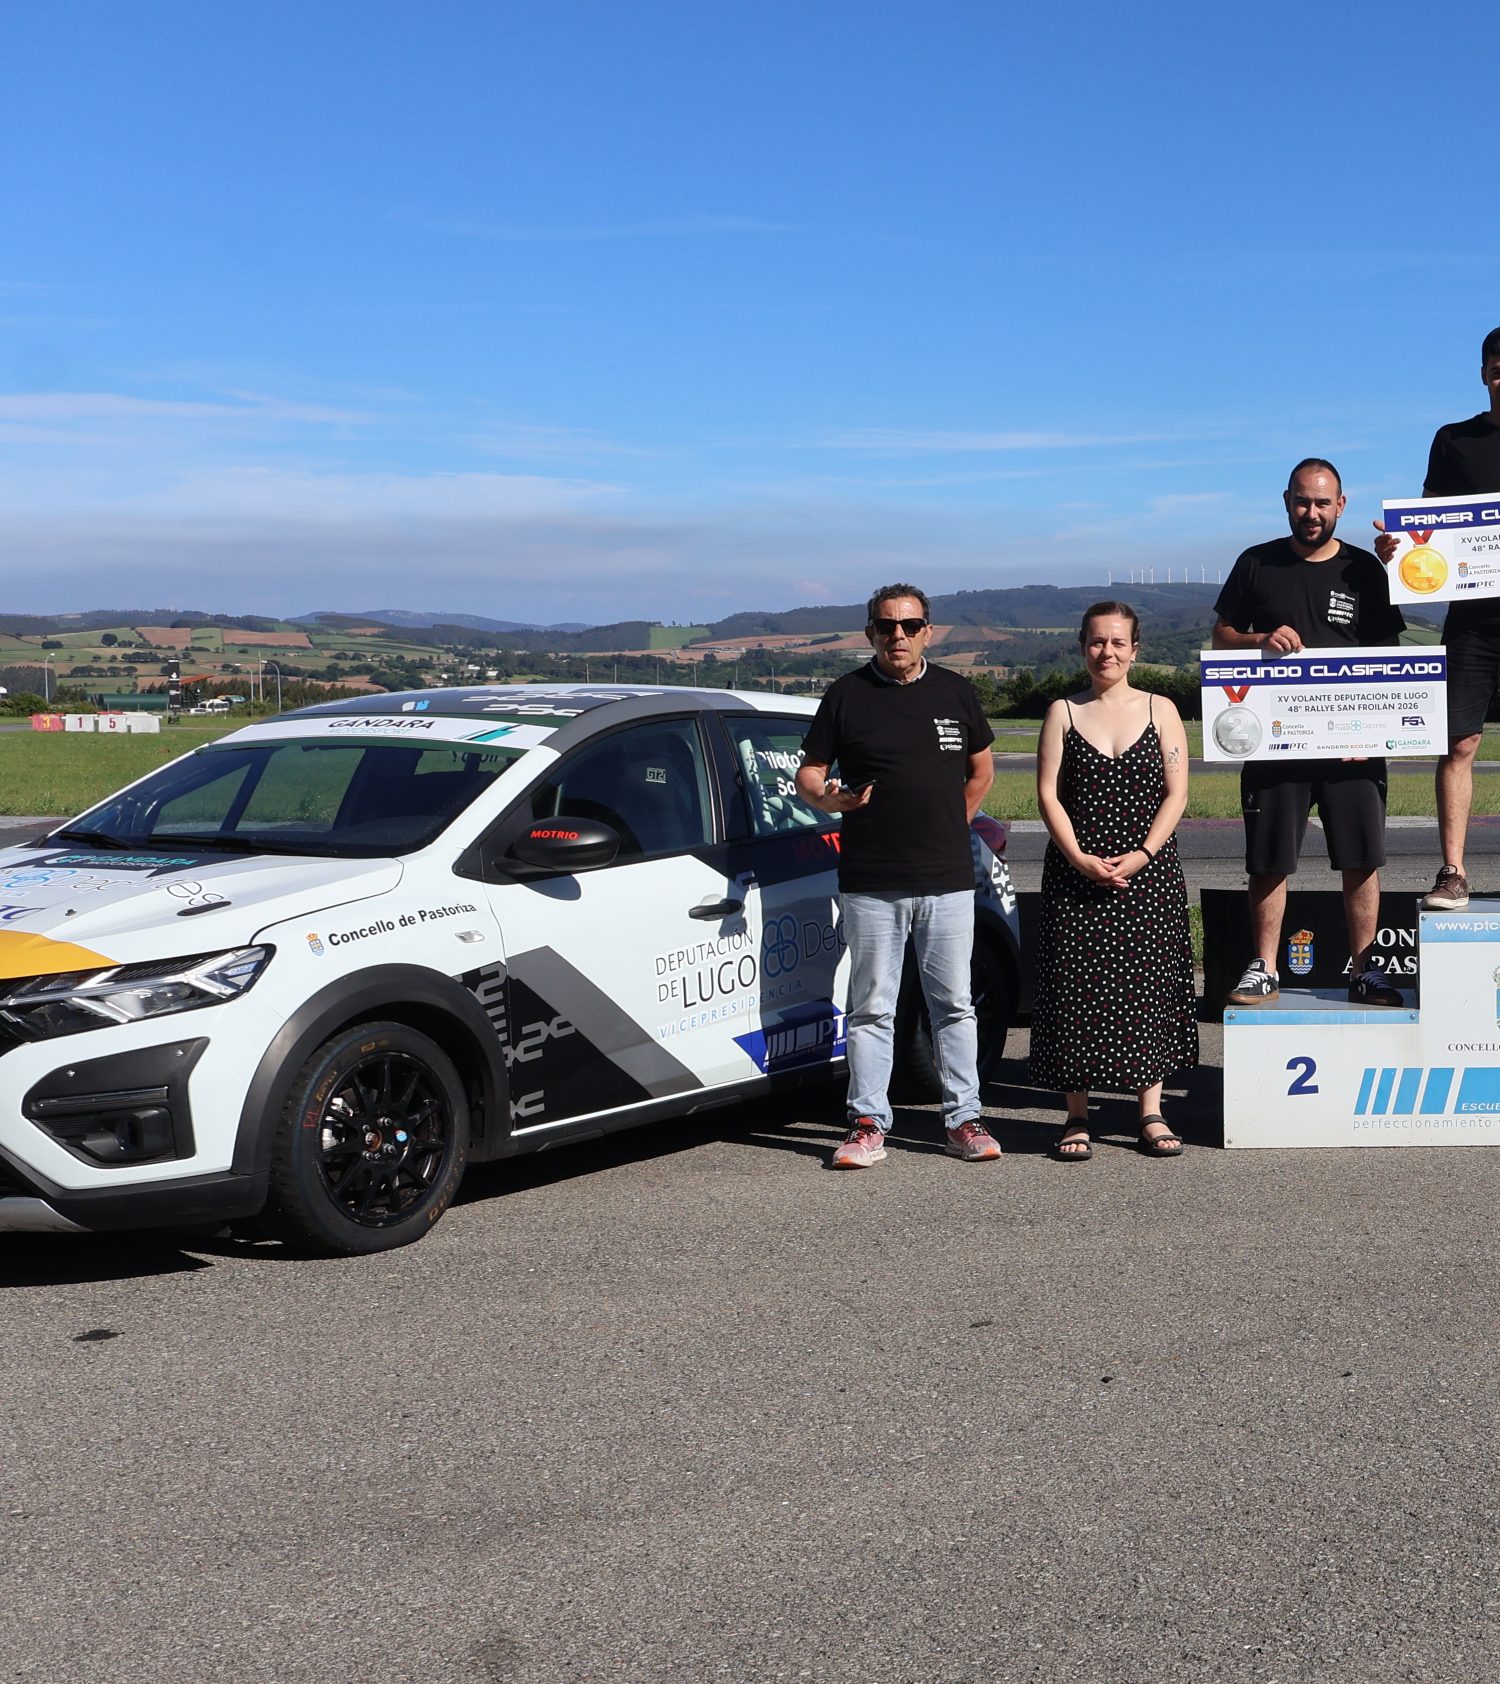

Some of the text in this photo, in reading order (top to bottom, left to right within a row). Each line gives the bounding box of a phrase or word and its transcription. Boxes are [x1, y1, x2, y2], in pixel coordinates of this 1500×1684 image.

[1401, 511, 1473, 526] PRIMER
[1461, 536, 1473, 544] XV
[1205, 662, 1442, 680] SEGUNDO CLASIFICADO
[1277, 692, 1428, 703] XV VOLANTE DEPUTACIÓN DE LUGO
[1305, 704, 1335, 712] RALLYE
[1337, 704, 1356, 712] SAN
[1357, 702, 1396, 711] FROILÁN
[1398, 702, 1419, 710] 2026
[78, 717, 83, 729] 1
[109, 717, 116, 729] 5
[530, 830, 580, 841] MOTRIO
[328, 903, 478, 946] Concello de Pastoriza
[655, 928, 754, 976] DEPUTACIÓN
[658, 954, 757, 1009] DE LUGO
[660, 981, 803, 1039] VICEPRESIDENCIA
[816, 1013, 847, 1045] PT
[1285, 1056, 1319, 1096] 2
[1353, 1116, 1493, 1131] perfeccionamiento
